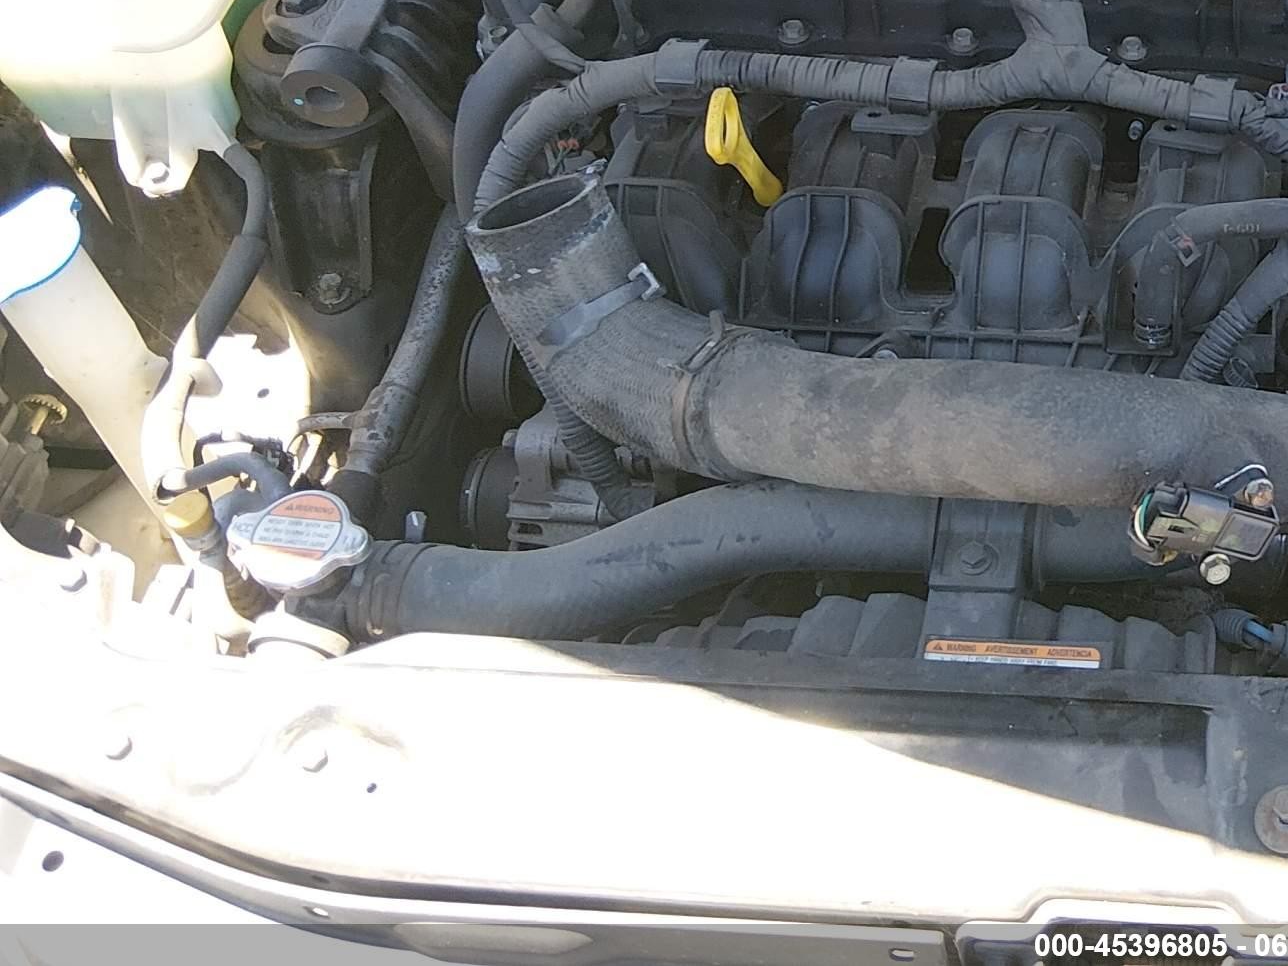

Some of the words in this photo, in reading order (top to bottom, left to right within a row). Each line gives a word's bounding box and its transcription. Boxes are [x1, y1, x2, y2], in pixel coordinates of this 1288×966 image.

[295, 504, 334, 514] WARNING
[946, 643, 976, 652] WARNING
[984, 644, 1039, 655] AVERTISSEMENT
[1047, 648, 1092, 658] ADVERTENCIA
